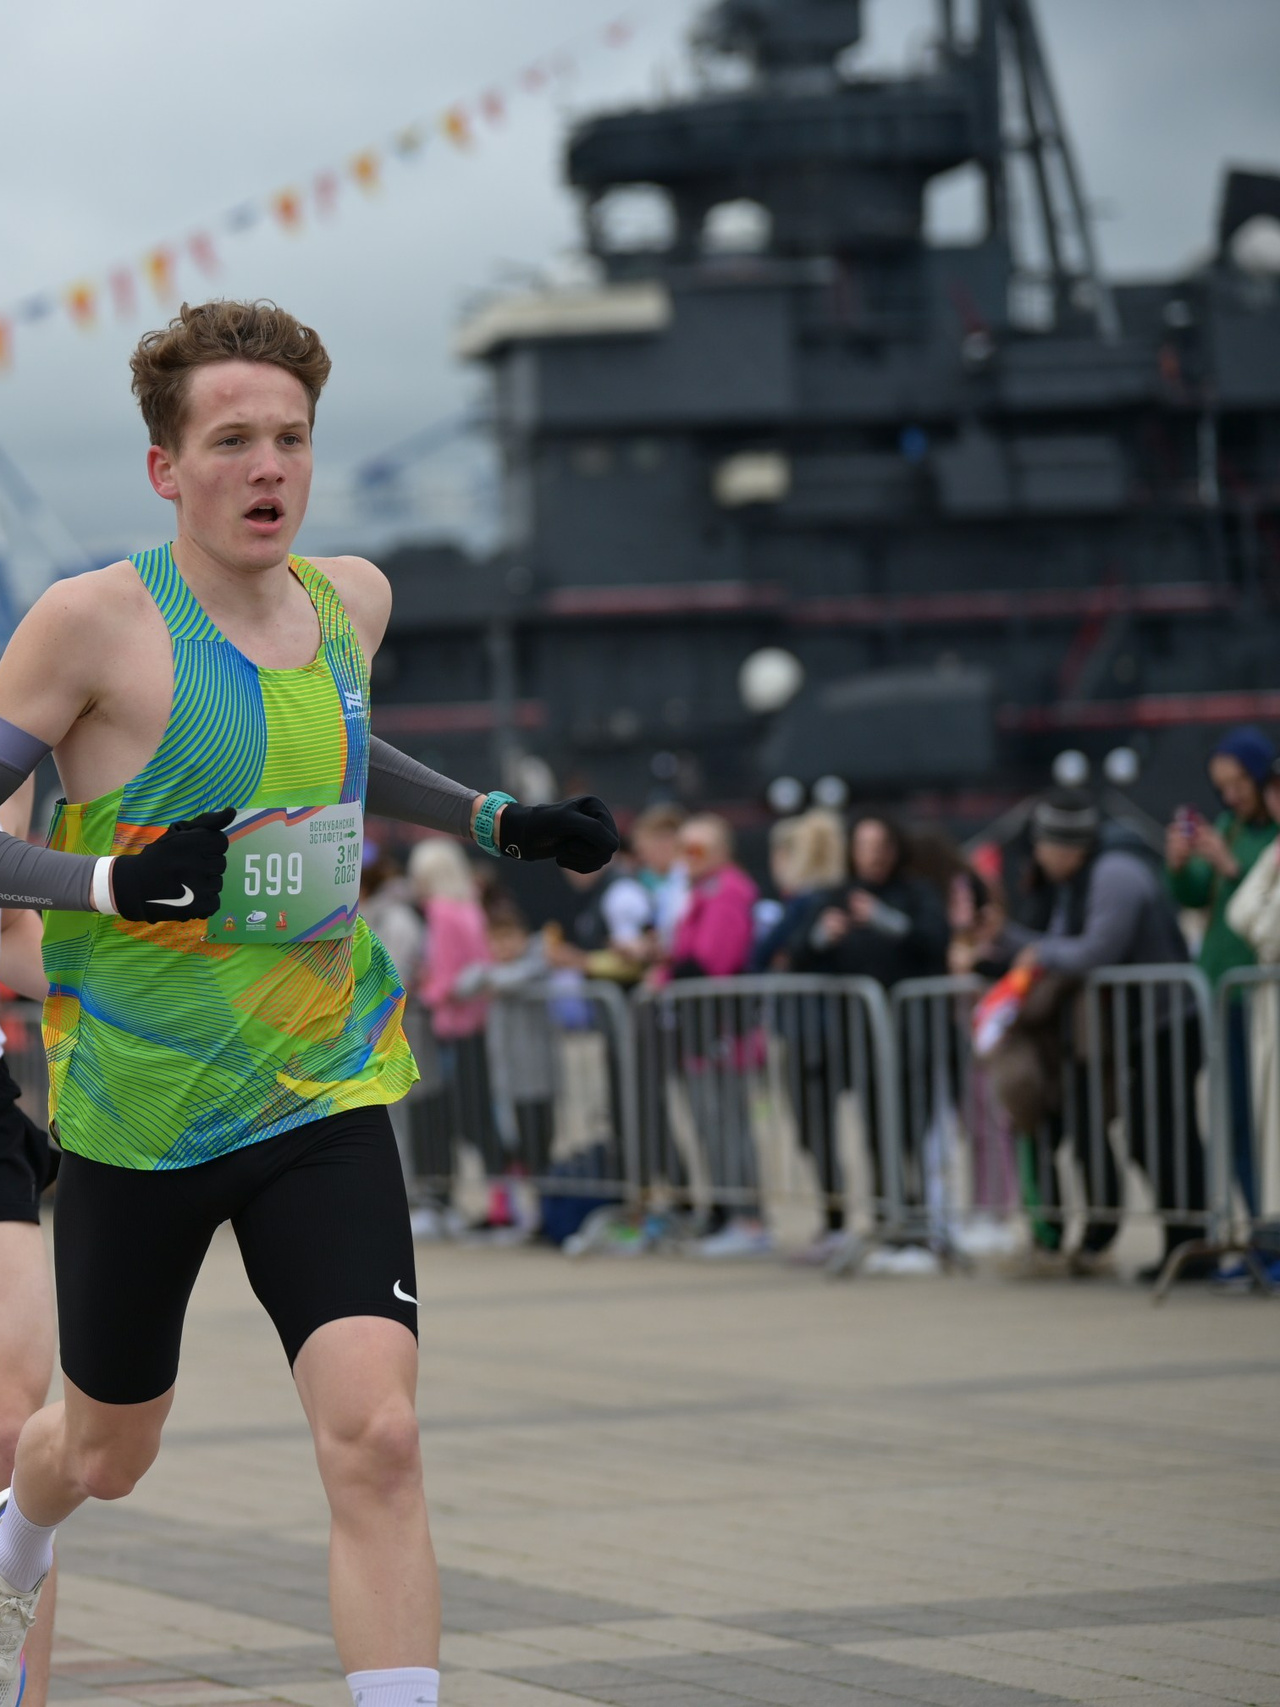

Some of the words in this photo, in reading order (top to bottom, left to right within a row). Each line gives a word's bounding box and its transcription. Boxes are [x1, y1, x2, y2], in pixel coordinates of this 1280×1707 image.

[309, 818, 355, 832] ВСЕКУБАНСКАЯ
[309, 832, 343, 845] ЭСТАФЕТА
[337, 845, 345, 864] 3
[347, 842, 360, 862] КМ
[244, 852, 302, 896] 599
[334, 864, 356, 885] 2025
